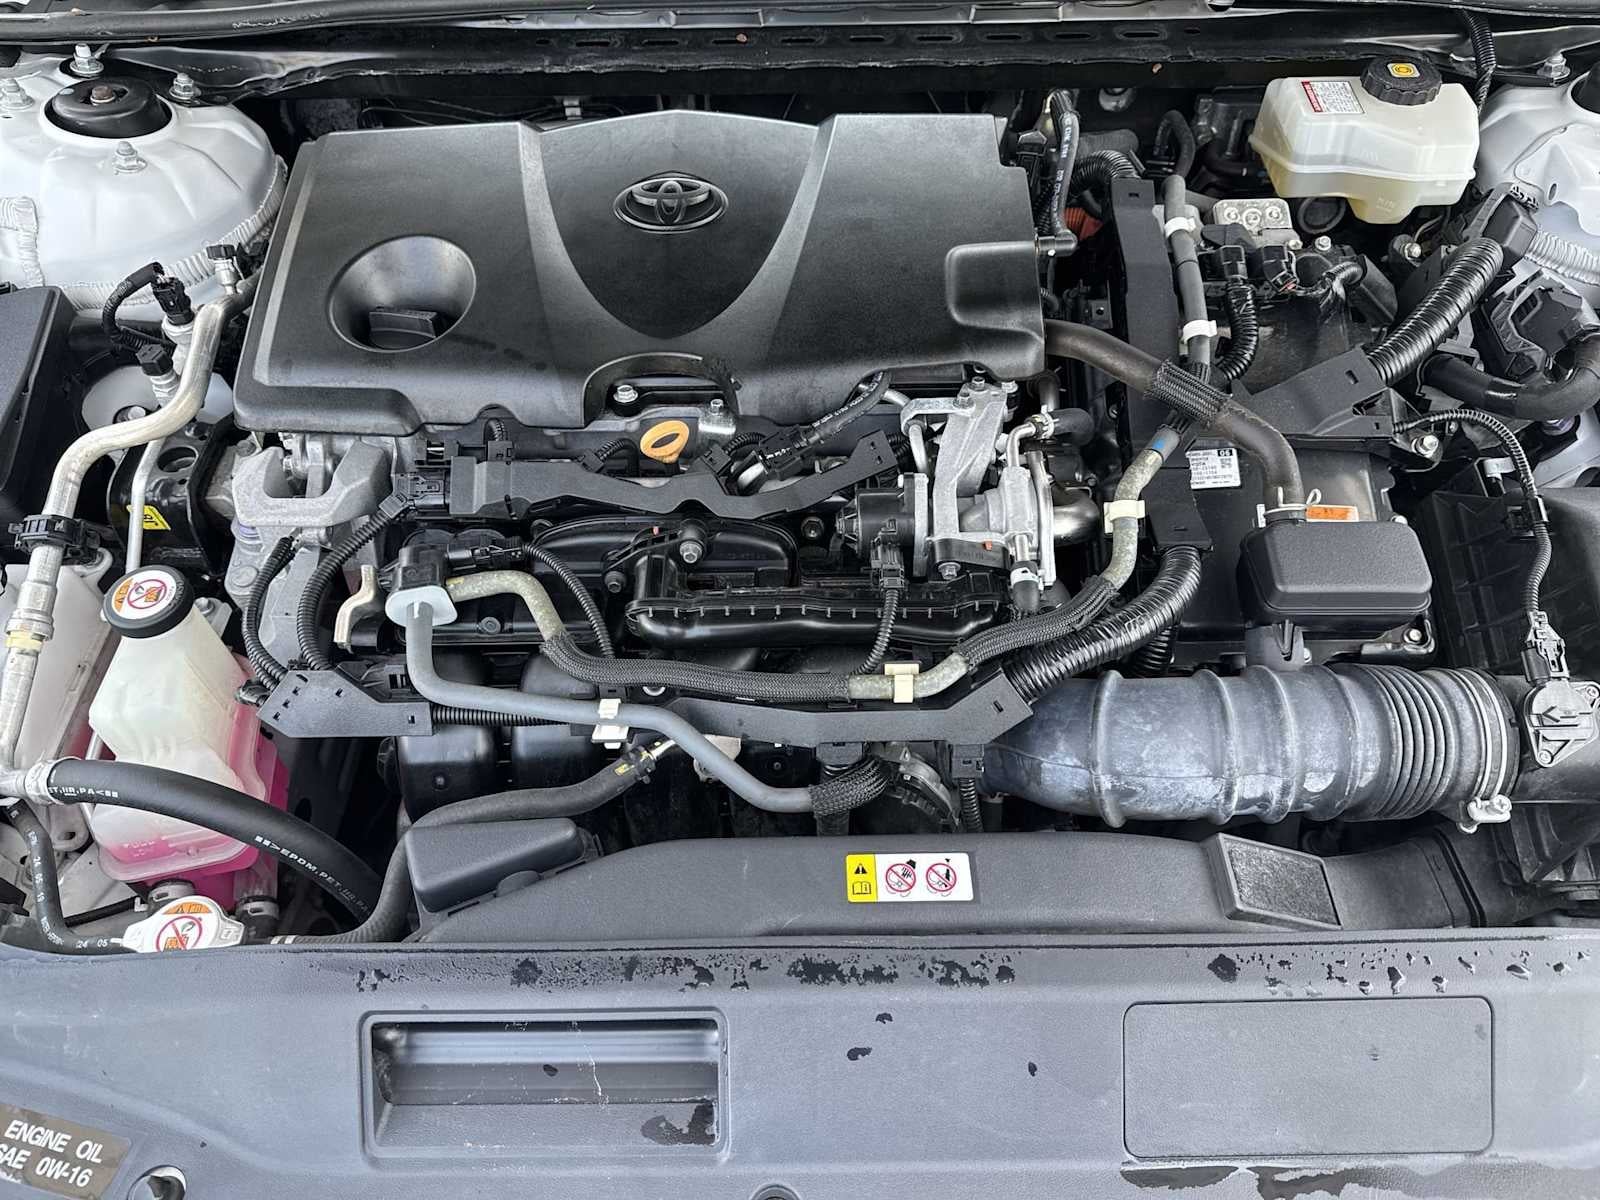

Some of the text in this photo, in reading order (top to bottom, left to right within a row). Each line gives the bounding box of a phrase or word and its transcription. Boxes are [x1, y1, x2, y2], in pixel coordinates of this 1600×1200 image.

[4, 1120, 103, 1164] ENGINE OIL
[35, 1157, 93, 1188] 0W-16
